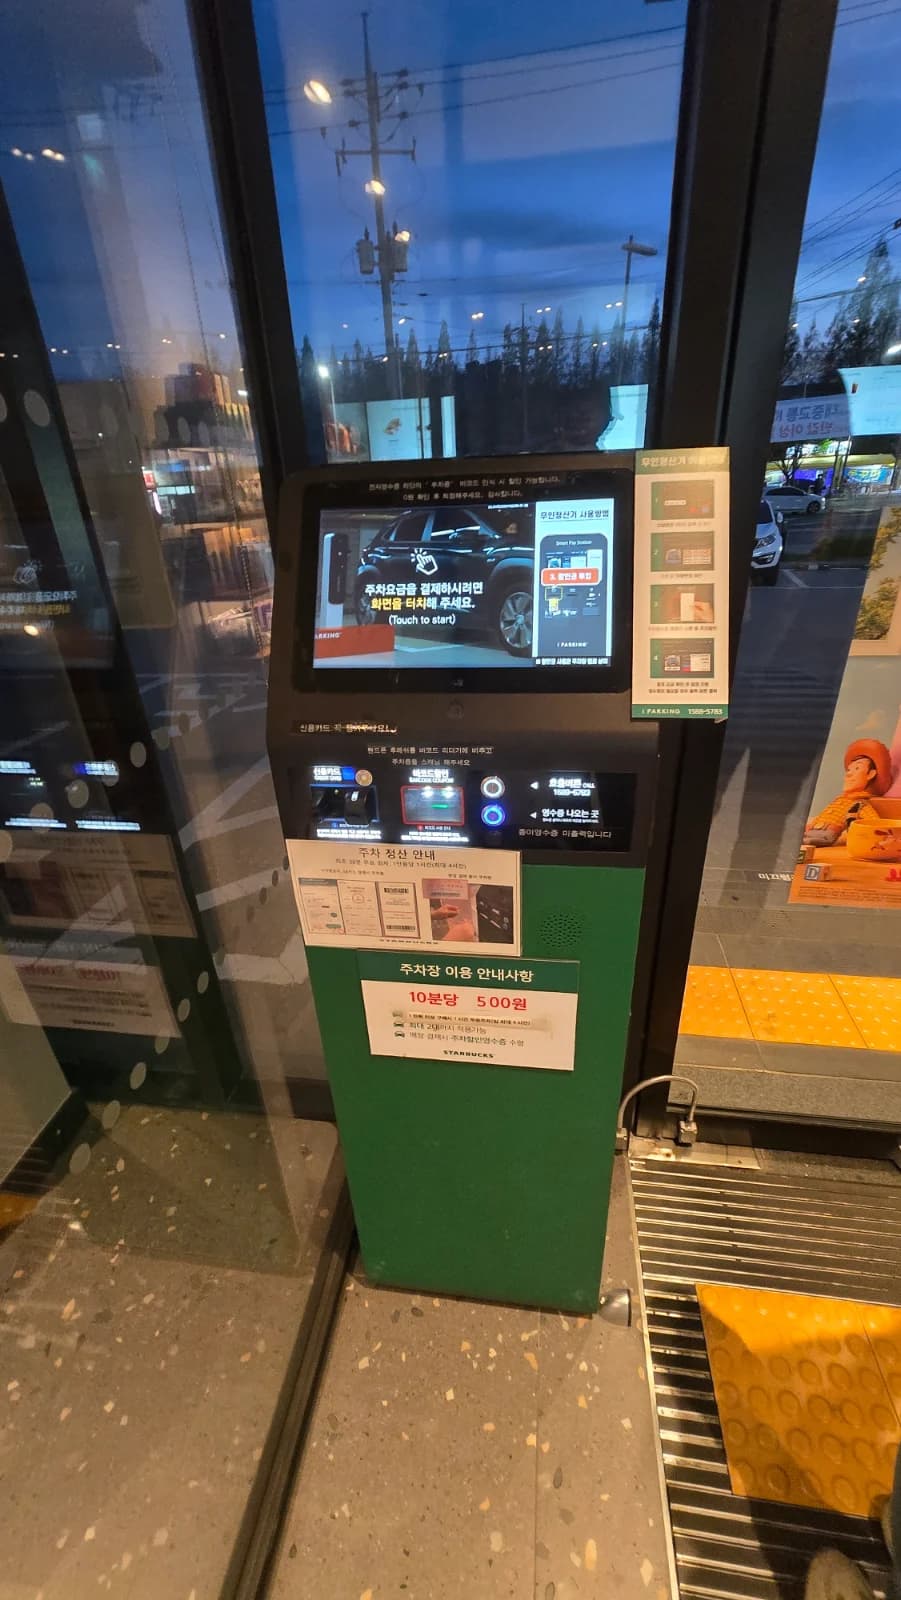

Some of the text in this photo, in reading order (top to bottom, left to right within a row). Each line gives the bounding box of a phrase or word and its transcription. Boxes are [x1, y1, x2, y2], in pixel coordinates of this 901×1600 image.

[540, 508, 609, 520] 무인정산기 사용방법
[363, 581, 483, 597] 주차요금을 결제하시려면
[370, 596, 475, 611] 화면을 터치해 주세요.
[387, 613, 455, 626] (Touch to start)
[300, 724, 331, 733] 신용카드
[418, 746, 439, 754] 바코드
[313, 767, 342, 776] 신용카드
[548, 778, 583, 789] 호출버튼
[541, 808, 600, 819] 영수증 나오는 곳
[518, 828, 613, 839] 종이영수증 미출력입니다
[359, 847, 436, 861] 주차 정산 안내
[400, 962, 535, 984] 주차장 이용 안내사항
[408, 990, 528, 1012] 10분당 500원
[443, 1049, 495, 1059] STARBUCKS
